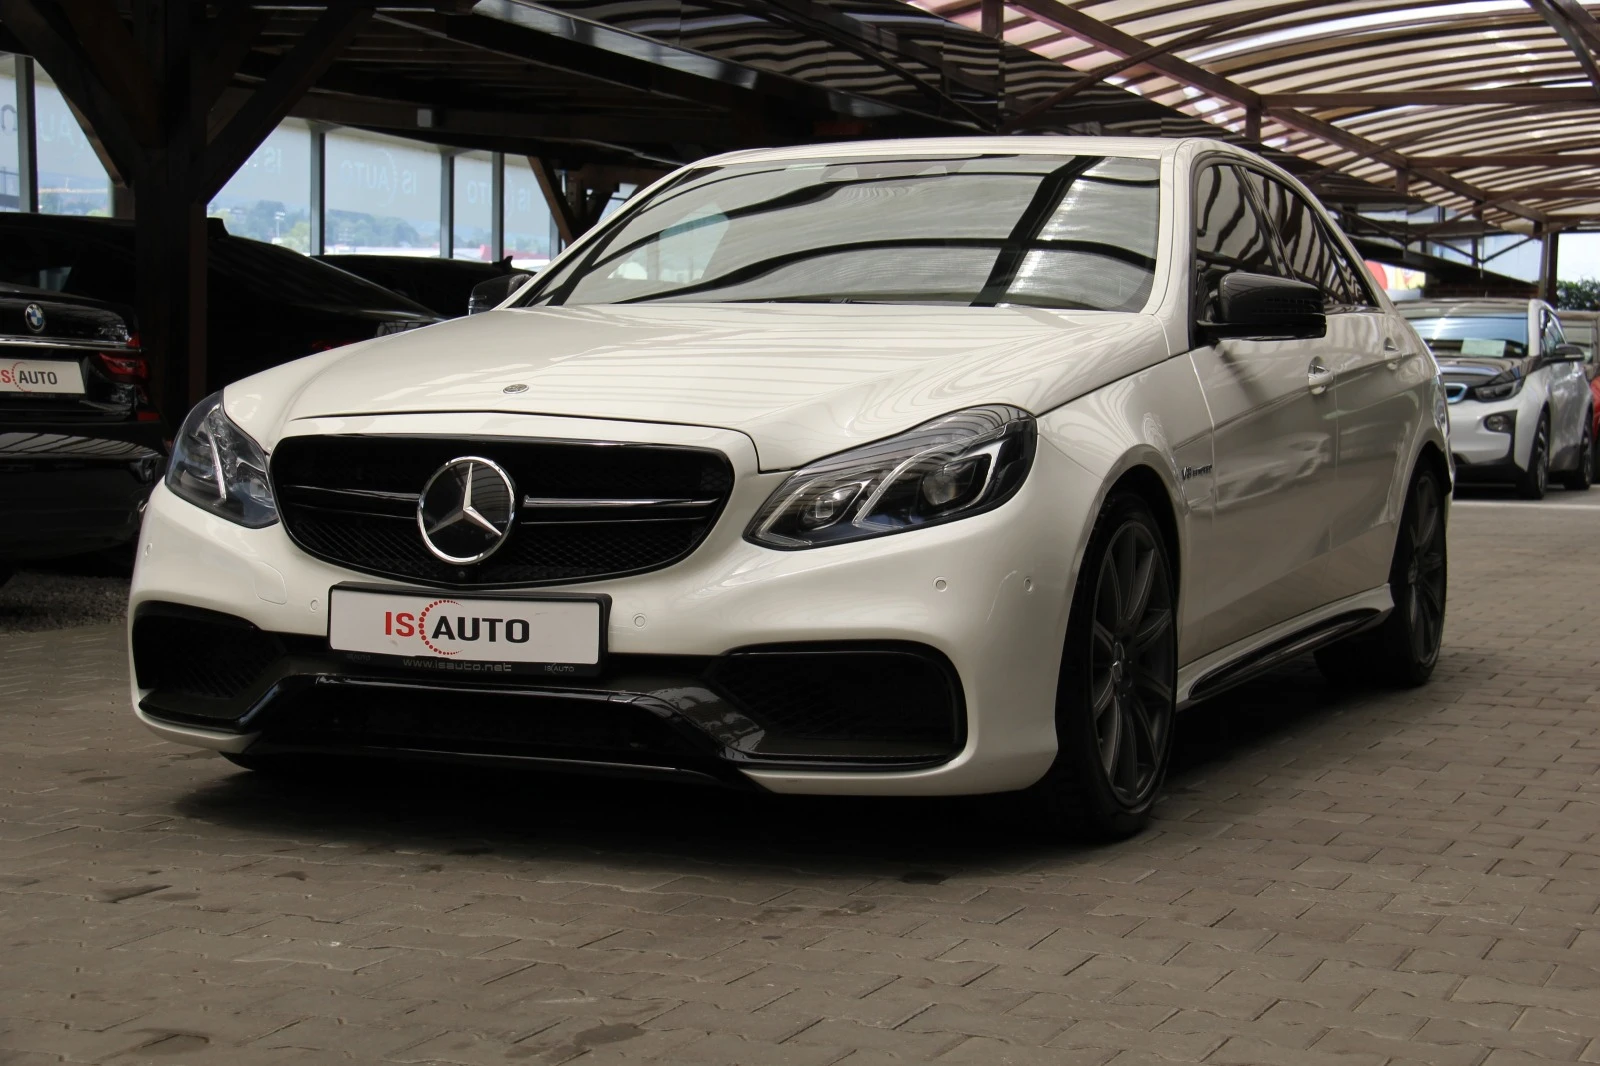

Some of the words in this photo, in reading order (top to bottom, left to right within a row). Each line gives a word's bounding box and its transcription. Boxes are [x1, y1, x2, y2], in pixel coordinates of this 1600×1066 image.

[18, 370, 58, 385] AUTO
[385, 611, 415, 637] IS
[431, 615, 530, 643] AUTO
[403, 658, 512, 672] www.isauto.net
